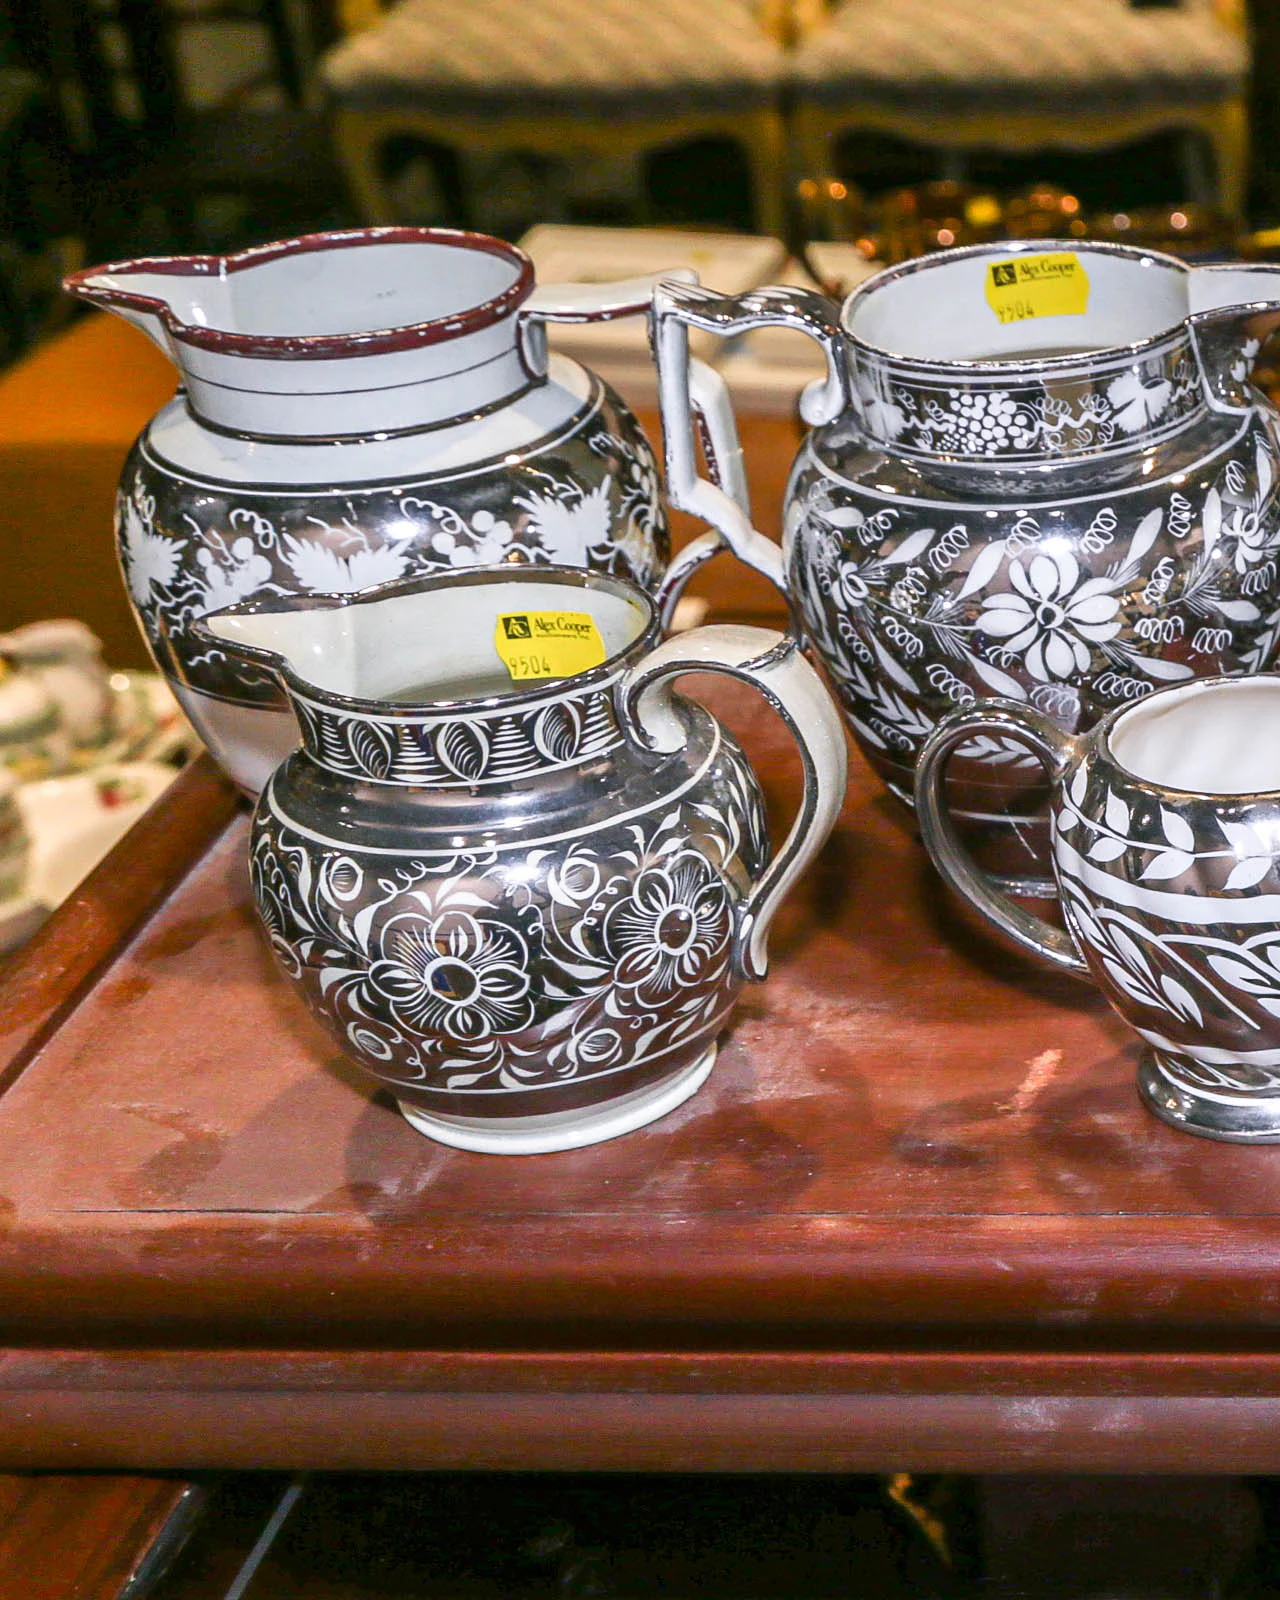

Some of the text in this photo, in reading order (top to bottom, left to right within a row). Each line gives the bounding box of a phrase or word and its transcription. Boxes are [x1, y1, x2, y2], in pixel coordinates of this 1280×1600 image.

[535, 617, 555, 632] Alex
[557, 617, 592, 634] Cooper
[510, 655, 551, 676] 9504
